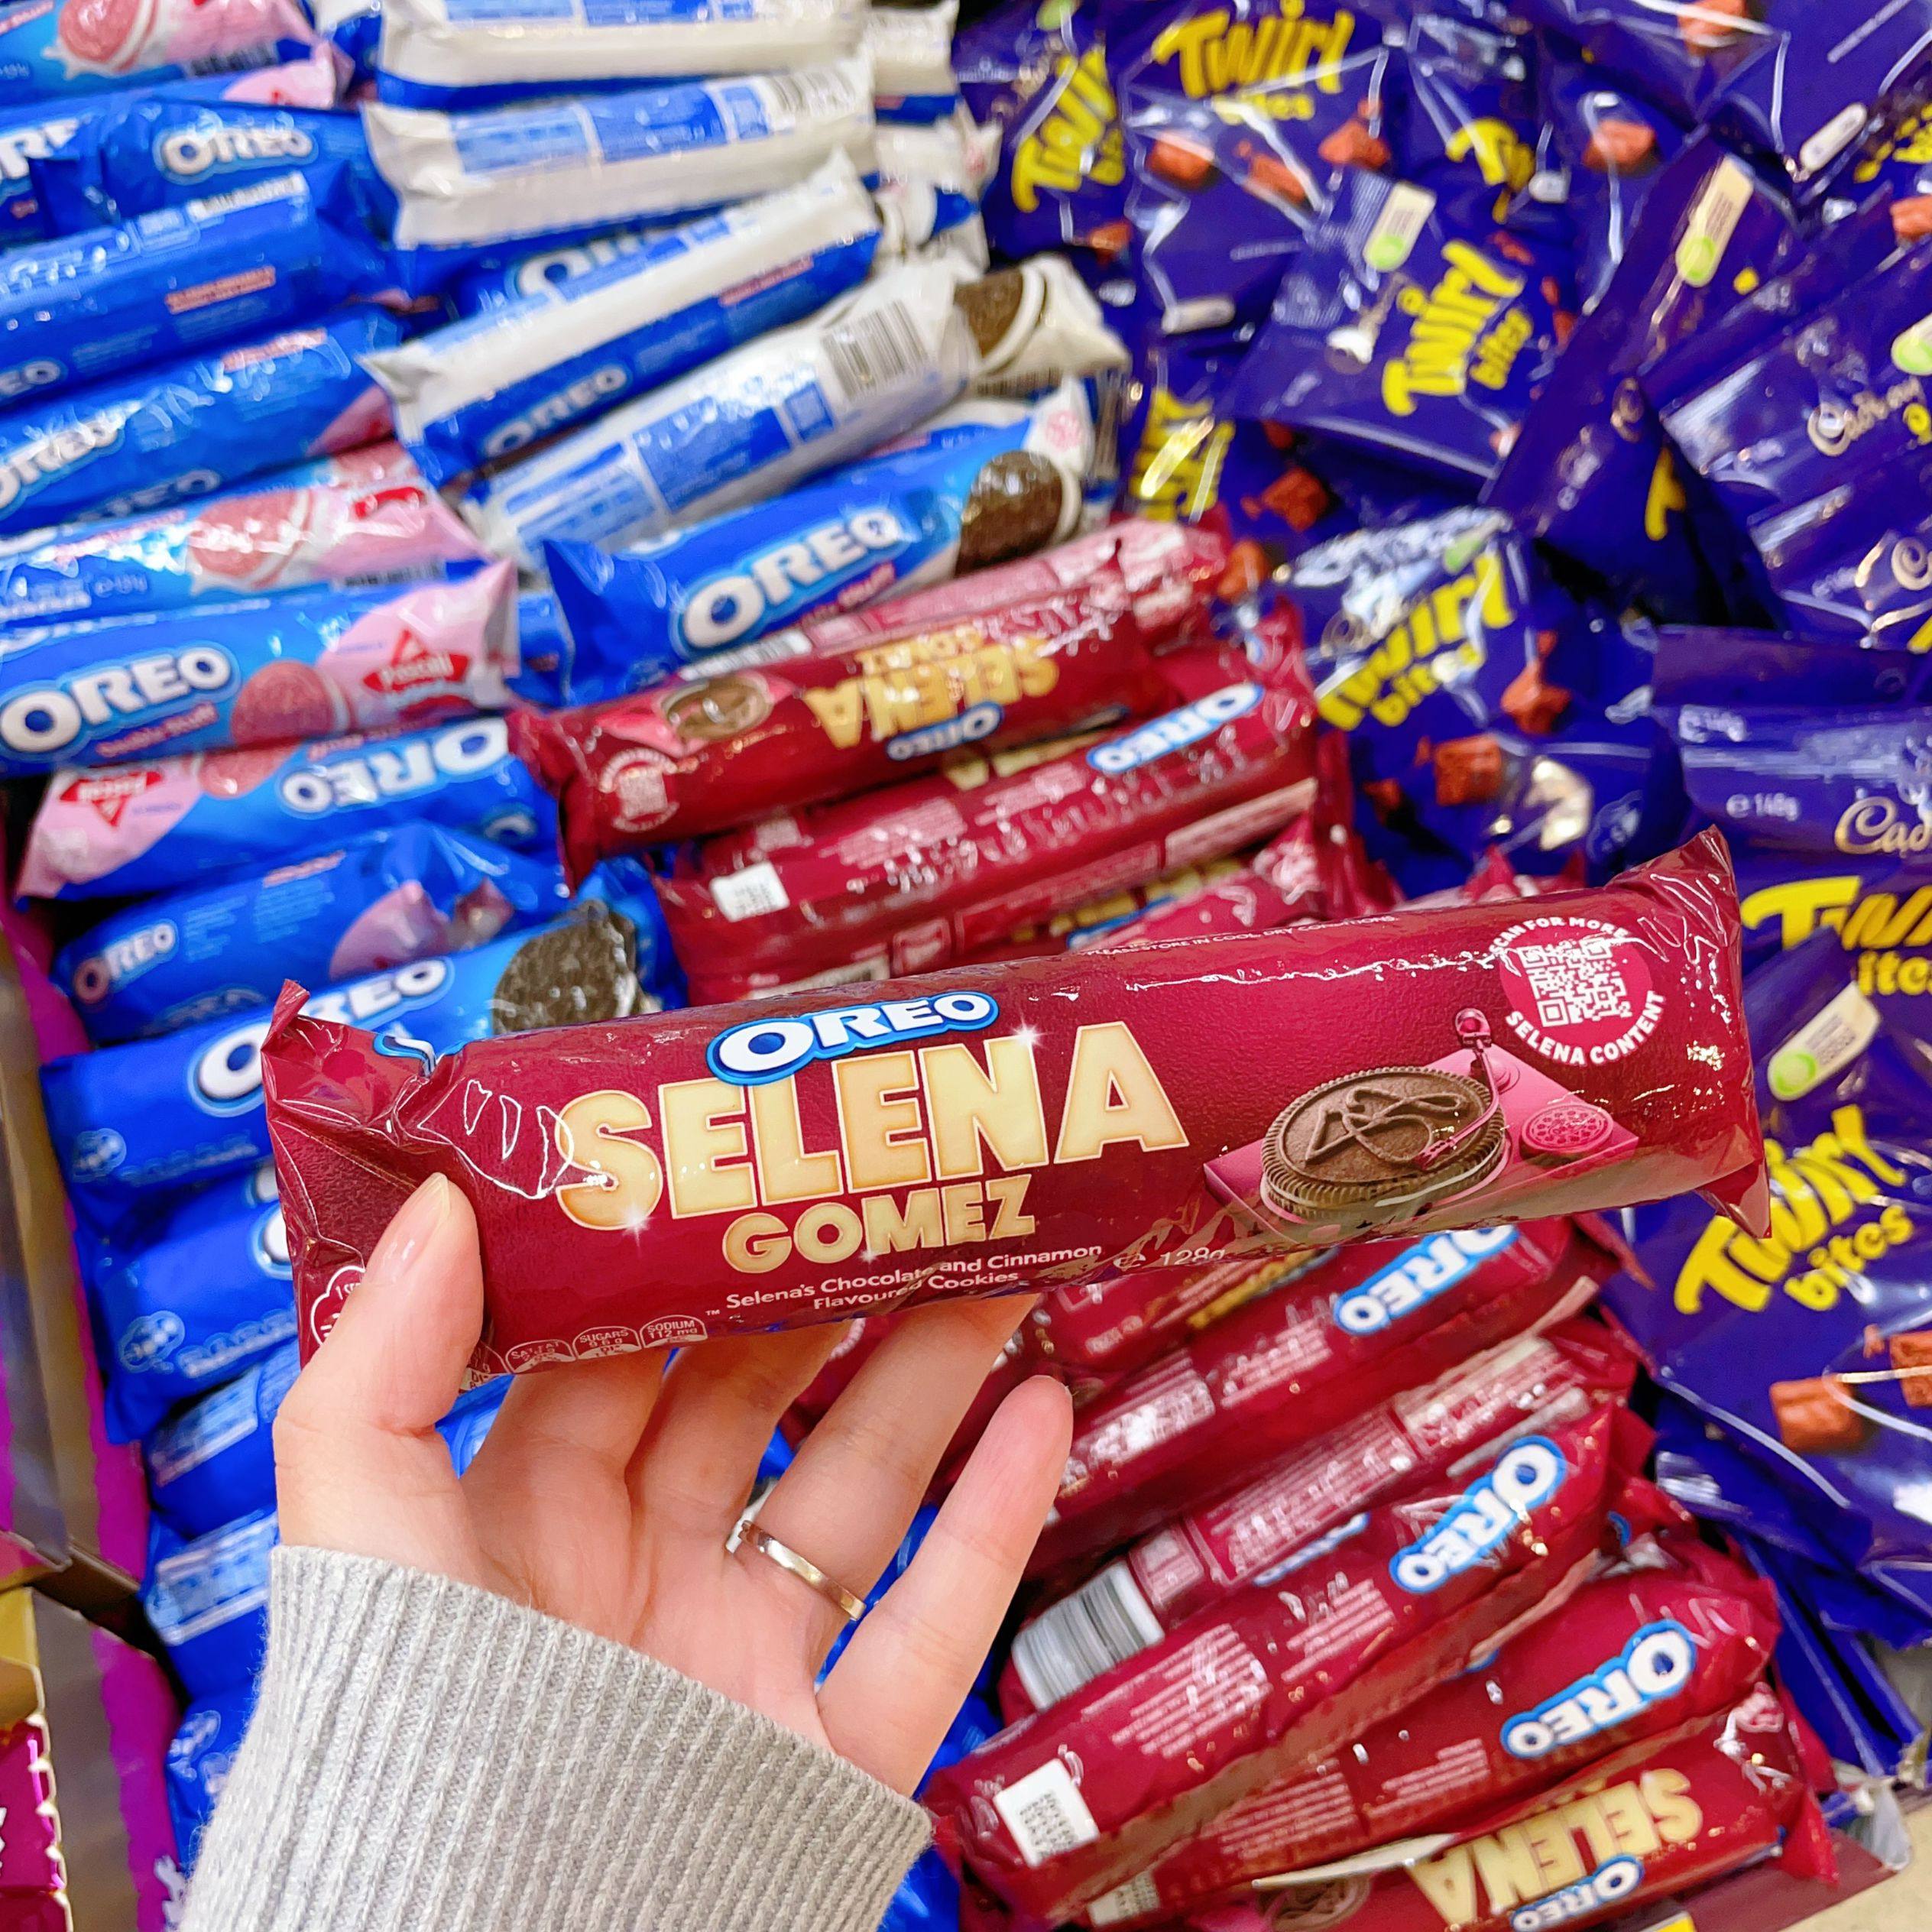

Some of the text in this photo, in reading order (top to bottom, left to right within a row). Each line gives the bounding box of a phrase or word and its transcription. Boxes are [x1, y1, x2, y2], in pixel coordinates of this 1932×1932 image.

[1151, 0, 1355, 99] Twirl
[1382, 239, 1525, 417] Twirl
[485, 366, 627, 457] OREO
[682, 511, 902, 648] OREO
[2, 647, 231, 752] OREO
[803, 636, 1060, 750] SELENA
[1093, 682, 1257, 772] OREO
[283, 716, 508, 814] OREO
[73, 923, 177, 1004] OREO
[1263, 928, 1293, 936] DRY
[1523, 916, 1566, 931] FOR
[1569, 916, 1629, 940] MORE
[717, 993, 990, 1075] OREO
[1505, 990, 1665, 1065] SELENA CONTENT
[554, 1020, 1191, 1232] SELENA
[721, 1174, 1036, 1274] GOMEZ
[1674, 1103, 1908, 1315] Twirl
[1783, 1204, 1914, 1311] bites
[647, 1319, 695, 1333] SODIUM
[724, 1245, 1103, 1309] Selena's Chocolate and Cinnamon
[813, 1270, 1019, 1310] Flavoured Cookies
[579, 1330, 629, 1344] SUGARS
[1397, 1442, 1564, 1589] OREO
[1506, 1628, 1694, 1757] OREO
[1404, 1767, 1704, 1926] SELENA
[1511, 1858, 1641, 1932] OREO
